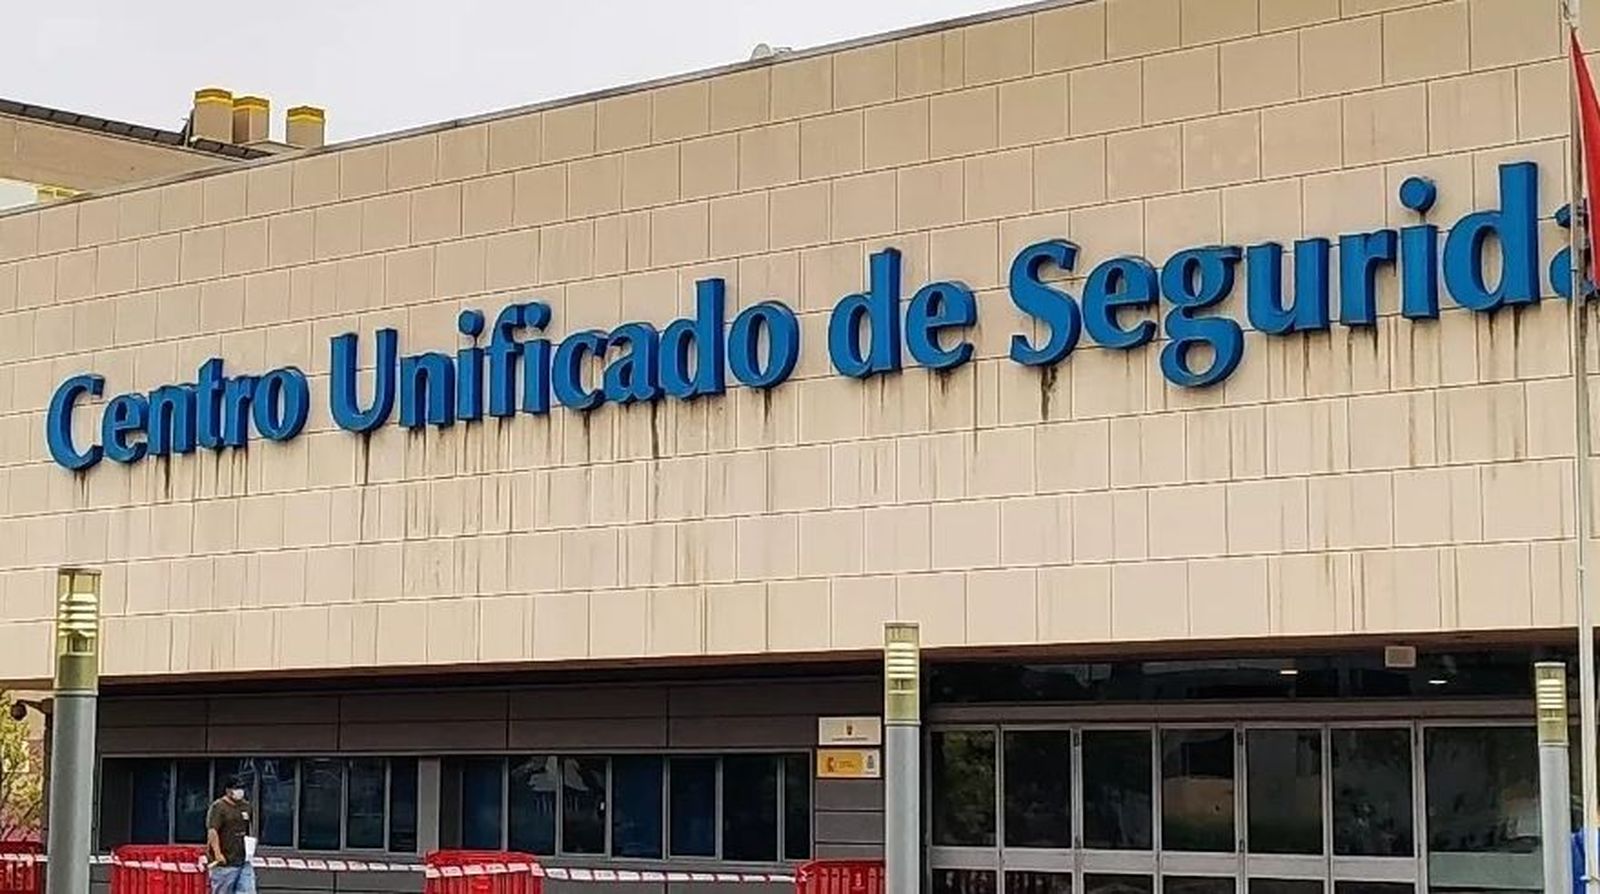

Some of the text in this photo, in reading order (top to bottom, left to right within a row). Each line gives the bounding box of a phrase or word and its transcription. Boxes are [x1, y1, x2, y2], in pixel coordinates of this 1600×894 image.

[46, 358, 309, 470] Centro
[330, 277, 799, 433] Unificado
[829, 247, 977, 379] de
